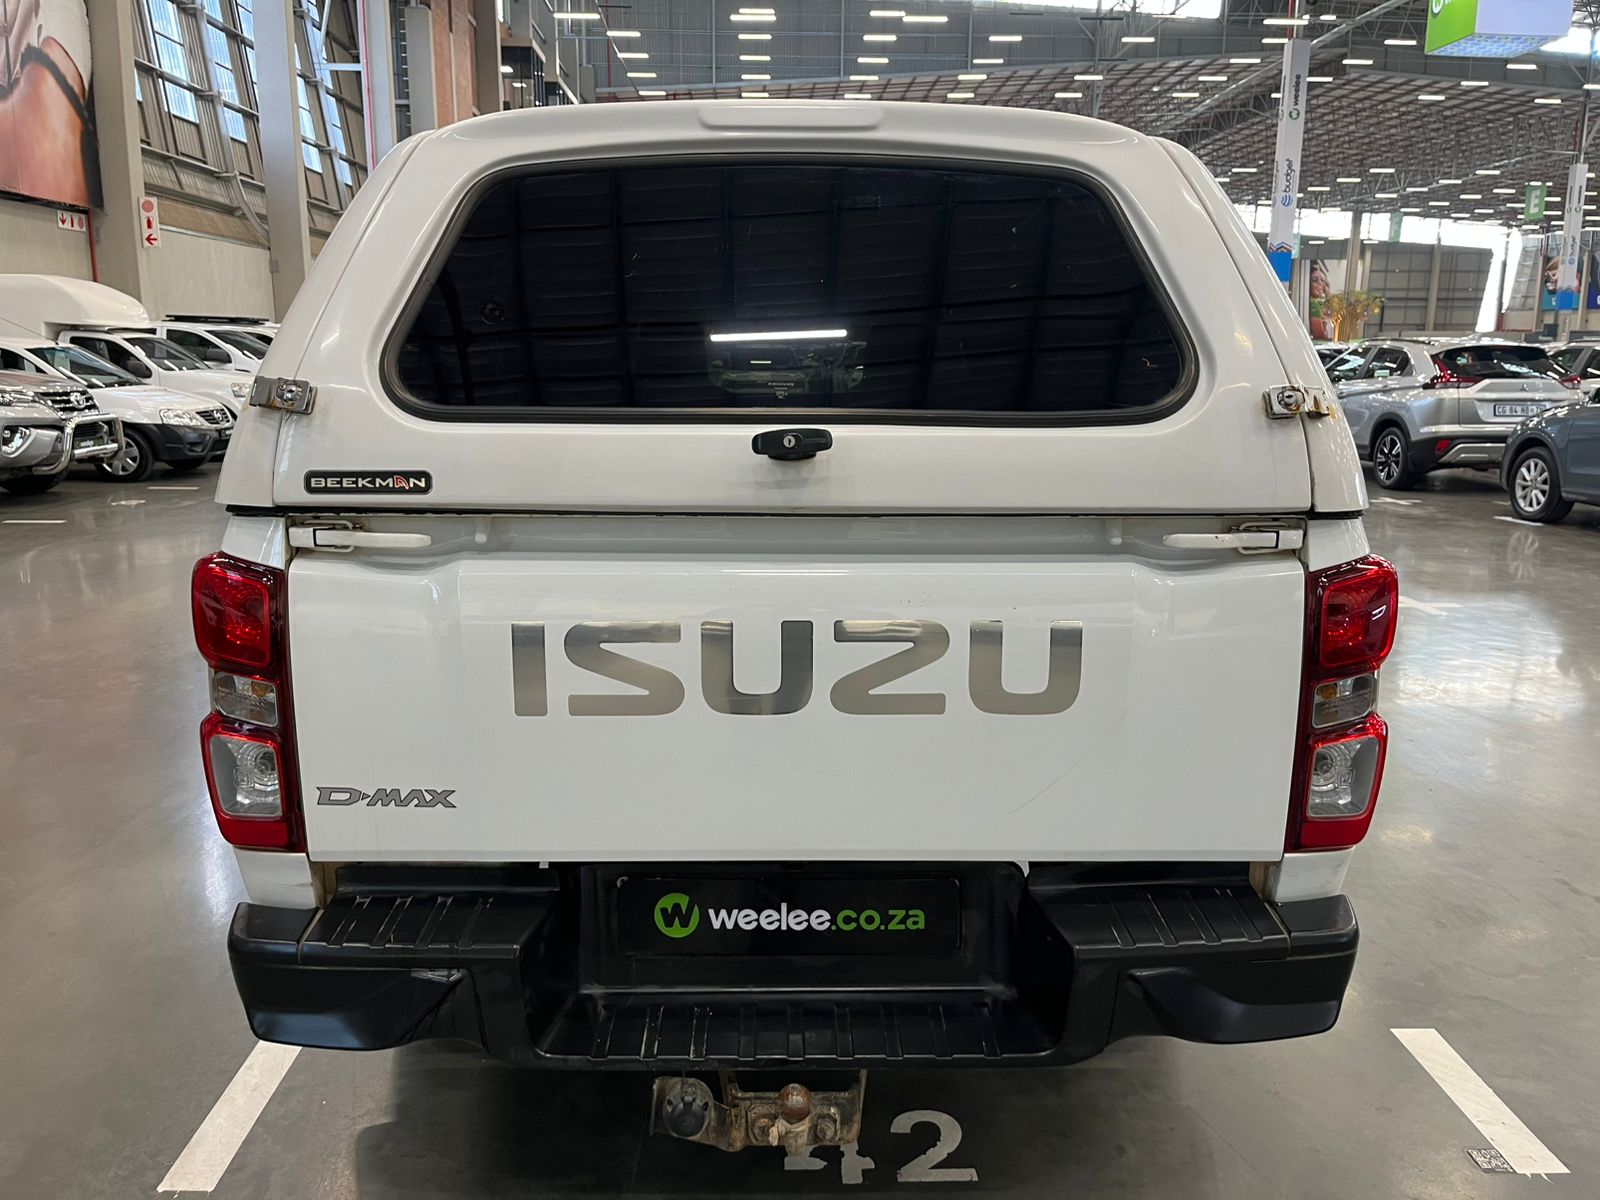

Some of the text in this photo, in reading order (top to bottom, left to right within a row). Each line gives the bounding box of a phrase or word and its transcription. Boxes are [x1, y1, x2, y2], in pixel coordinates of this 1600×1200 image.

[1292, 74, 1302, 106] weelee
[1284, 158, 1295, 193] budget
[1530, 189, 1541, 214] E
[311, 475, 426, 490] BEEKMAN
[511, 620, 1083, 717] ISUZU
[316, 787, 457, 808] D-MAX
[708, 902, 926, 931] weelee.co.za
